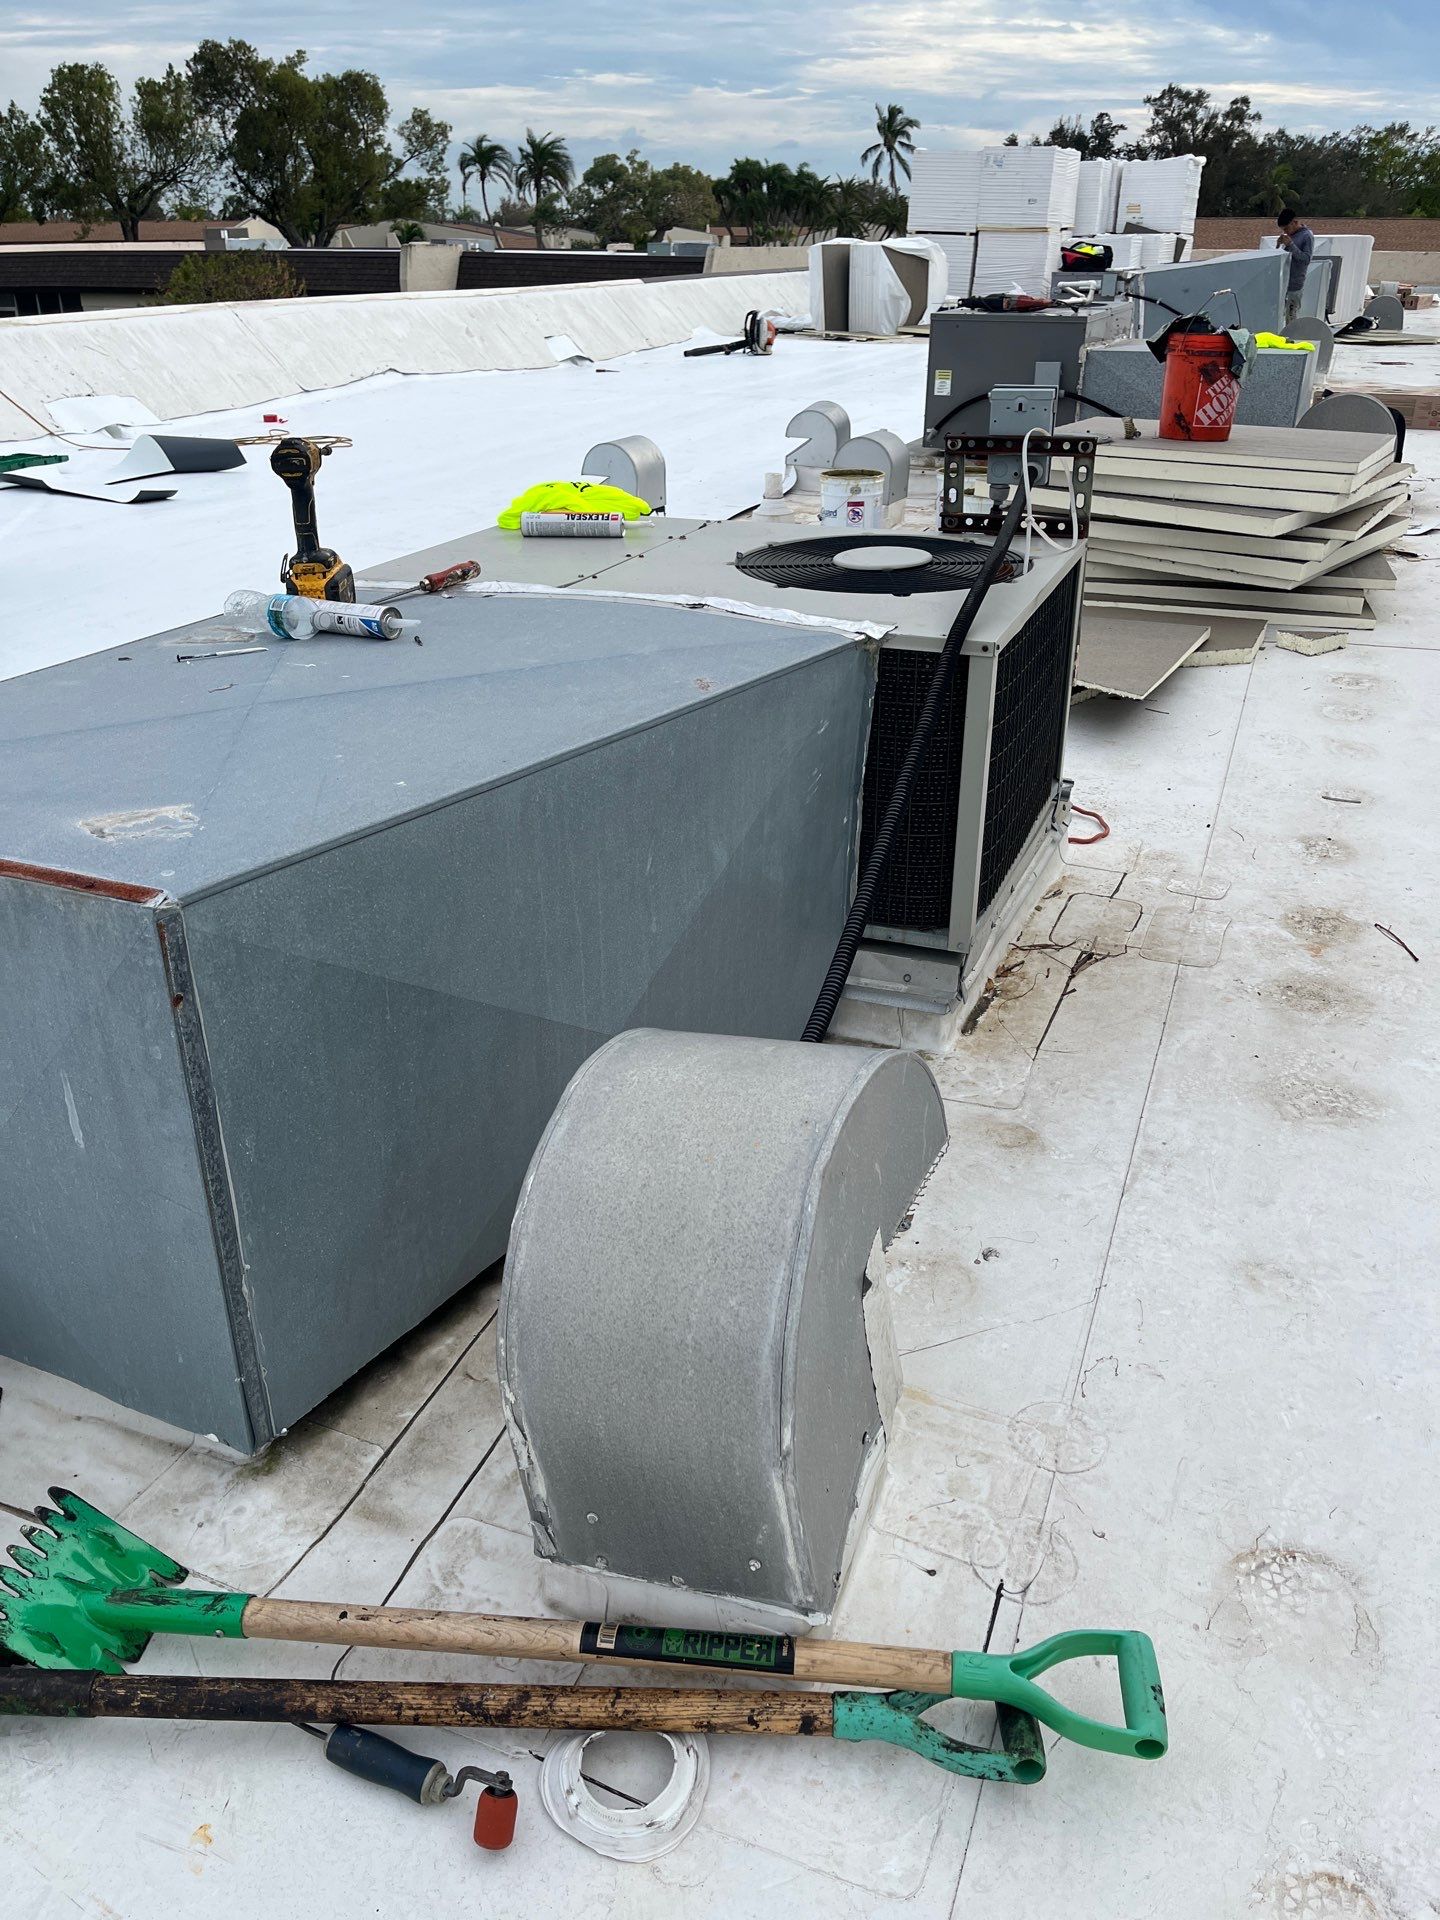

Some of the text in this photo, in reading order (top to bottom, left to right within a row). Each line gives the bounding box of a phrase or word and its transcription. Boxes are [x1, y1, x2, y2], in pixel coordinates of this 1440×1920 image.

[1205, 375, 1231, 398] THE
[566, 513, 610, 521] FLEXSEAL
[683, 1631, 773, 1663] RIPPER
